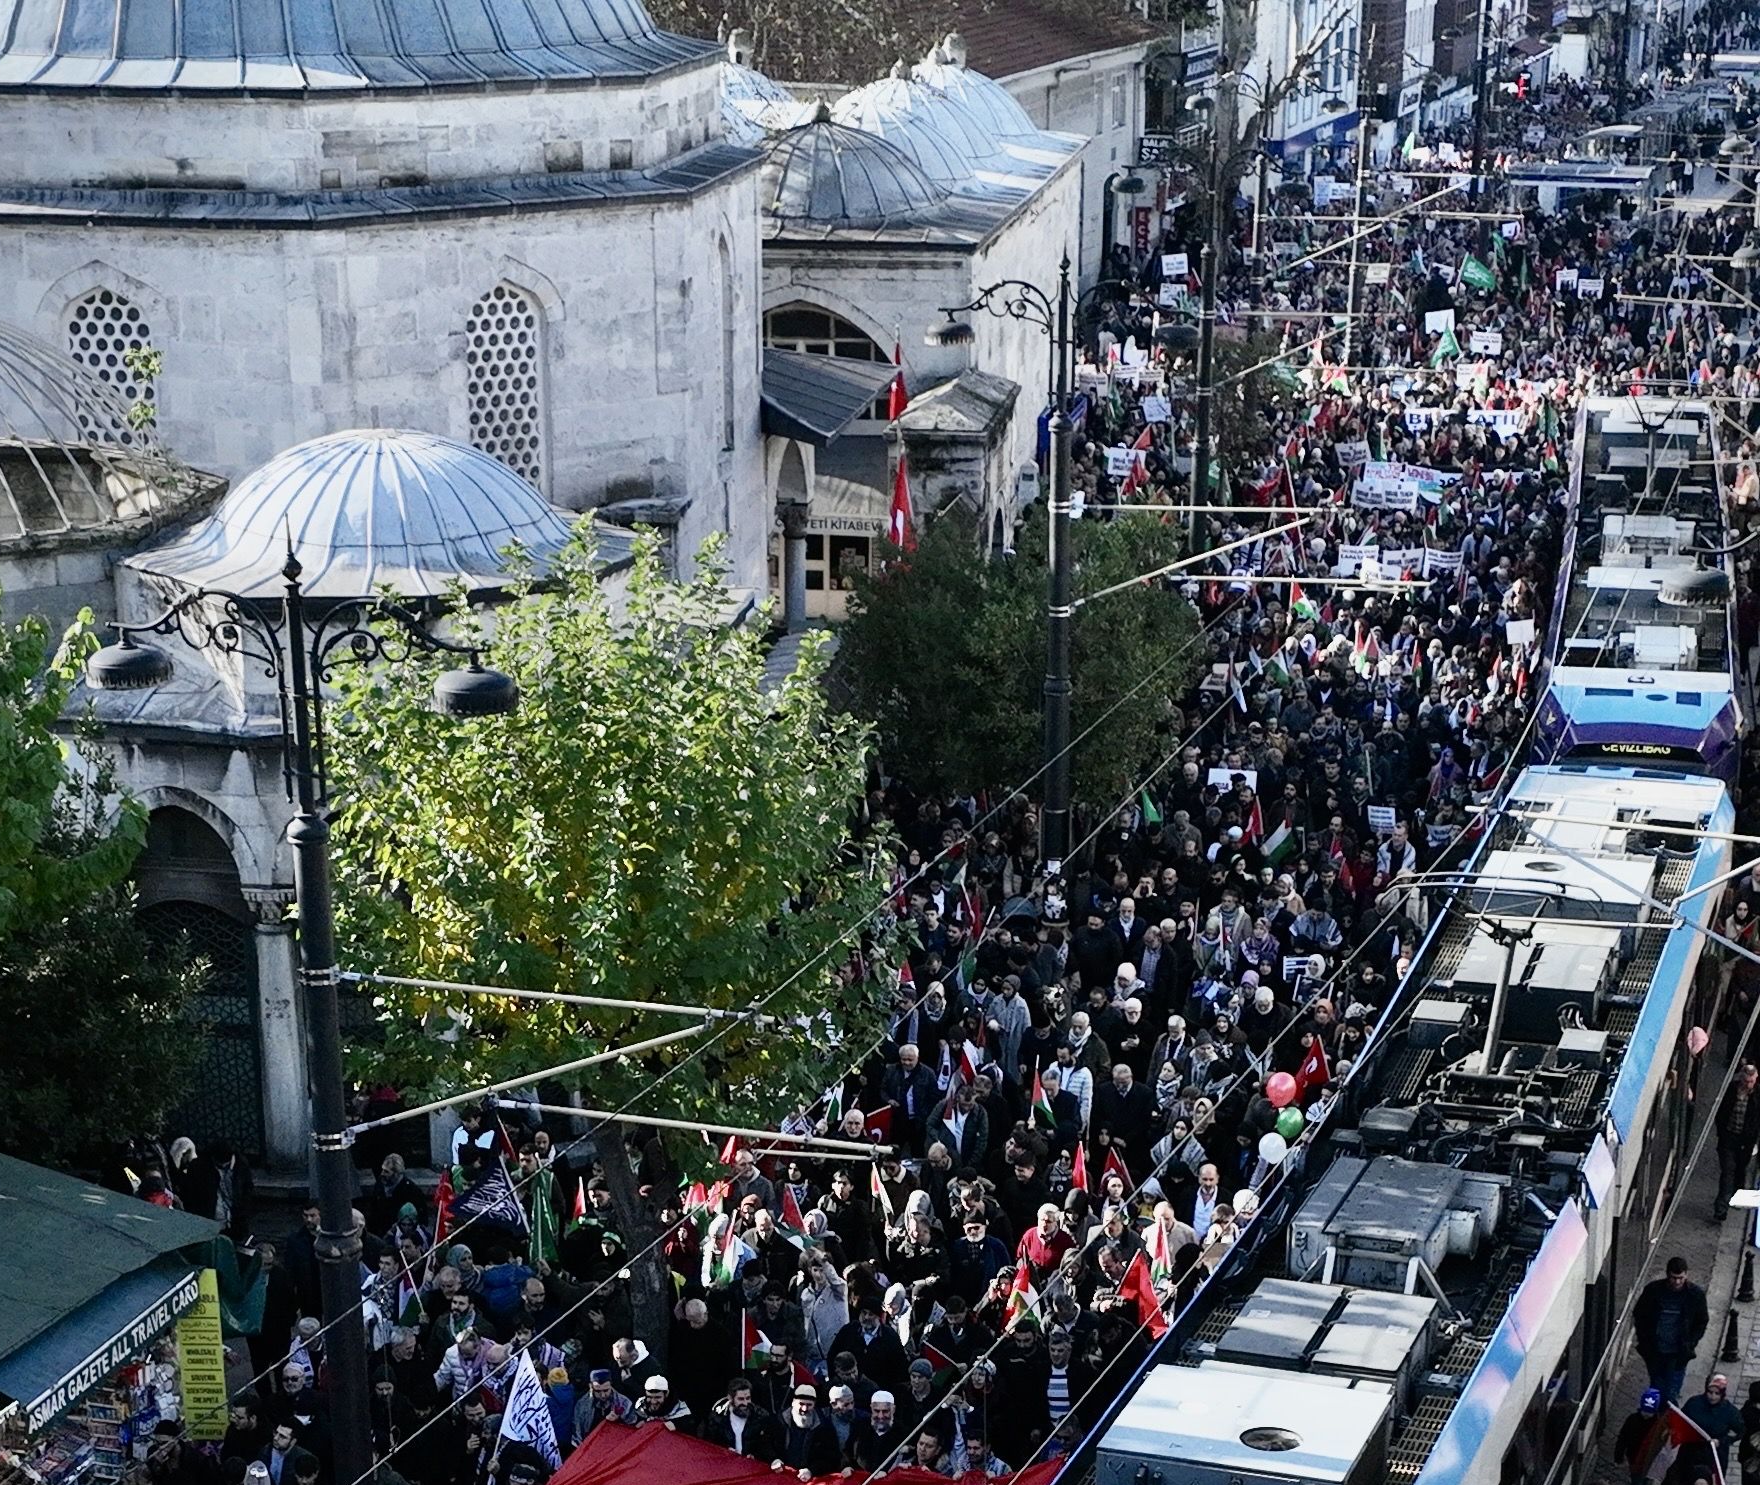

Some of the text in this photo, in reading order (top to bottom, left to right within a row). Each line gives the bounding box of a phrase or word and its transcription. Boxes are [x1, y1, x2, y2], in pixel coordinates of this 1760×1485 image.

[830, 517, 883, 532] KİTABEV
[28, 1389, 67, 1435] ASMAR
[67, 1357, 110, 1402] GAZETE
[111, 1337, 133, 1367] ALL
[131, 1303, 172, 1348] TRAVEL
[171, 1279, 199, 1313] CARD
